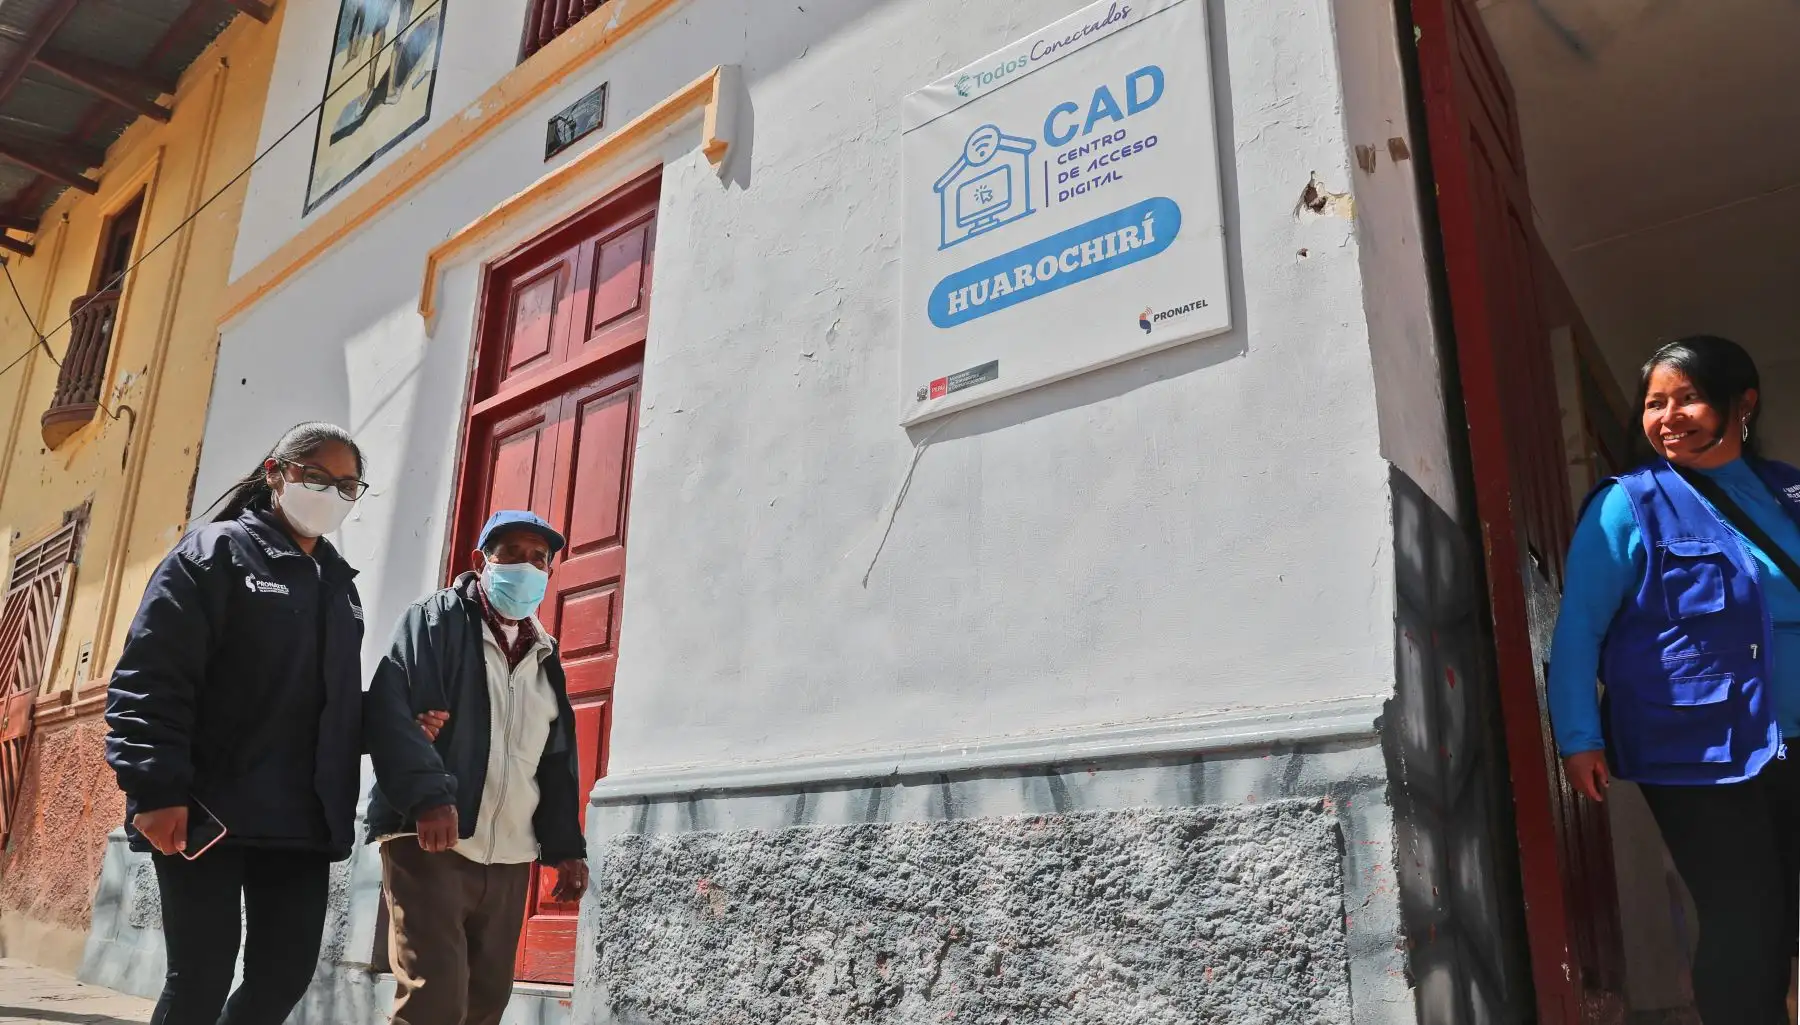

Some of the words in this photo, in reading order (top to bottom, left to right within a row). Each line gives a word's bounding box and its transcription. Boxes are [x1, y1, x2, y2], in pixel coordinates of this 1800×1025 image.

[973, 54, 1028, 89] Todos
[1030, 2, 1133, 61] Conectados
[1043, 64, 1165, 148] CAD
[1057, 128, 1127, 165] CENTRO
[1057, 166, 1080, 184] DE
[1086, 134, 1158, 173] ACCESO
[1058, 169, 1124, 203] DIGITAL
[947, 211, 1156, 316] HUAROCHIRÍ
[1153, 299, 1209, 323] PRONATEL
